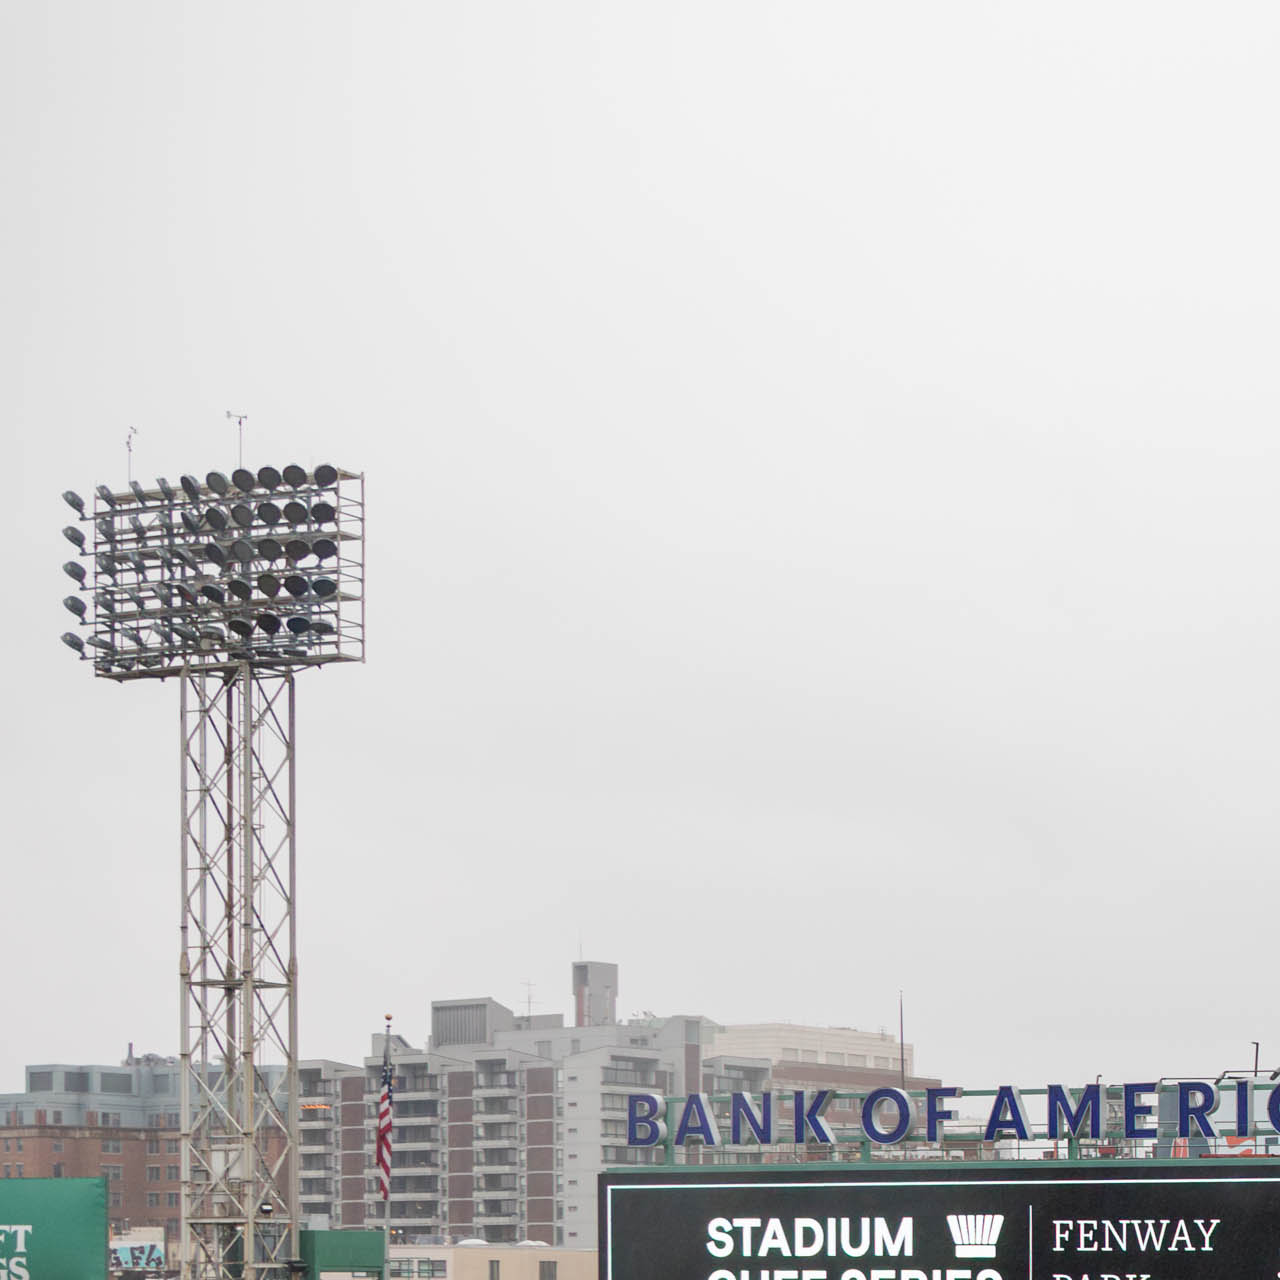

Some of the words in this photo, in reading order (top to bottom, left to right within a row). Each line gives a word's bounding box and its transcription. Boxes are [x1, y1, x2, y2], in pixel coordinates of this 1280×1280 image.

[626, 1089, 837, 1147] BANK
[861, 1086, 963, 1145] OF
[706, 1216, 914, 1258] STADIUM
[1052, 1219, 1221, 1252] FENWAY
